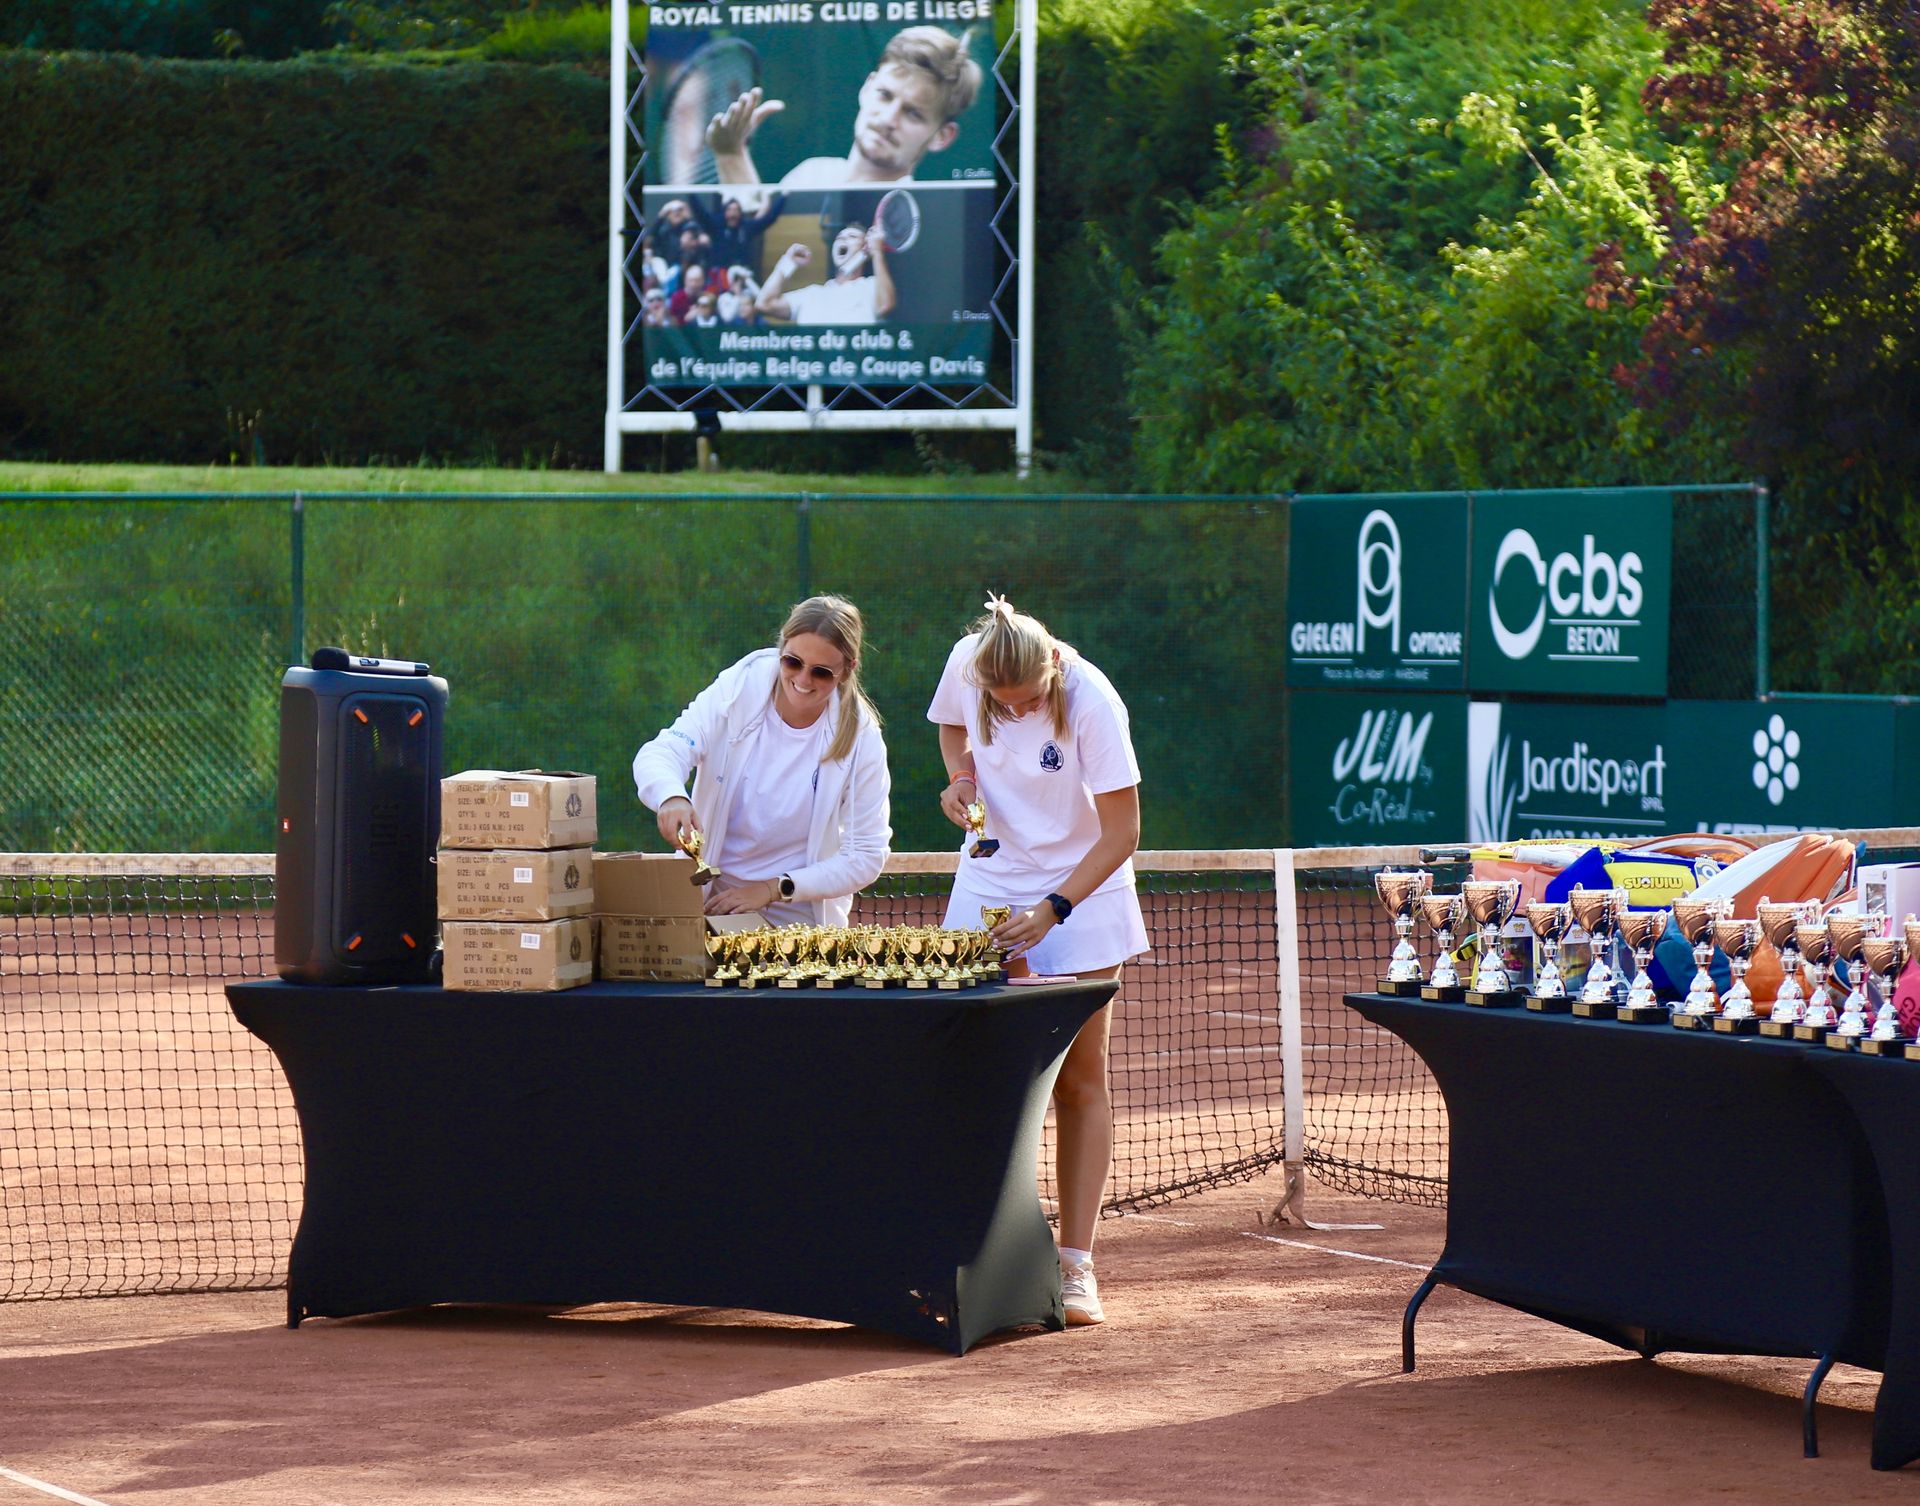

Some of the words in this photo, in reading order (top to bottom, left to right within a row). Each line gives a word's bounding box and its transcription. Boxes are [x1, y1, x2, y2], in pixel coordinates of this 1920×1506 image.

[650, 6, 722, 26] ROYAL
[729, 3, 813, 24] TENNIS
[820, 2, 880, 21] CLUB
[887, 1, 918, 20] DE
[719, 330, 814, 351] Membres
[818, 329, 847, 350] du
[851, 329, 894, 350] club
[898, 330, 913, 350] &
[651, 357, 677, 378] de
[680, 357, 761, 381] l'équipe
[766, 356, 824, 380] Belge
[829, 356, 857, 377] de
[861, 356, 925, 379] Coupe
[929, 355, 985, 376] Davis
[1549, 534, 1643, 617] cbs
[1291, 622, 1355, 654] GIELEN
[1409, 631, 1462, 656] OPTIQUE
[1567, 626, 1620, 653] BETON
[1332, 709, 1434, 784] JLM
